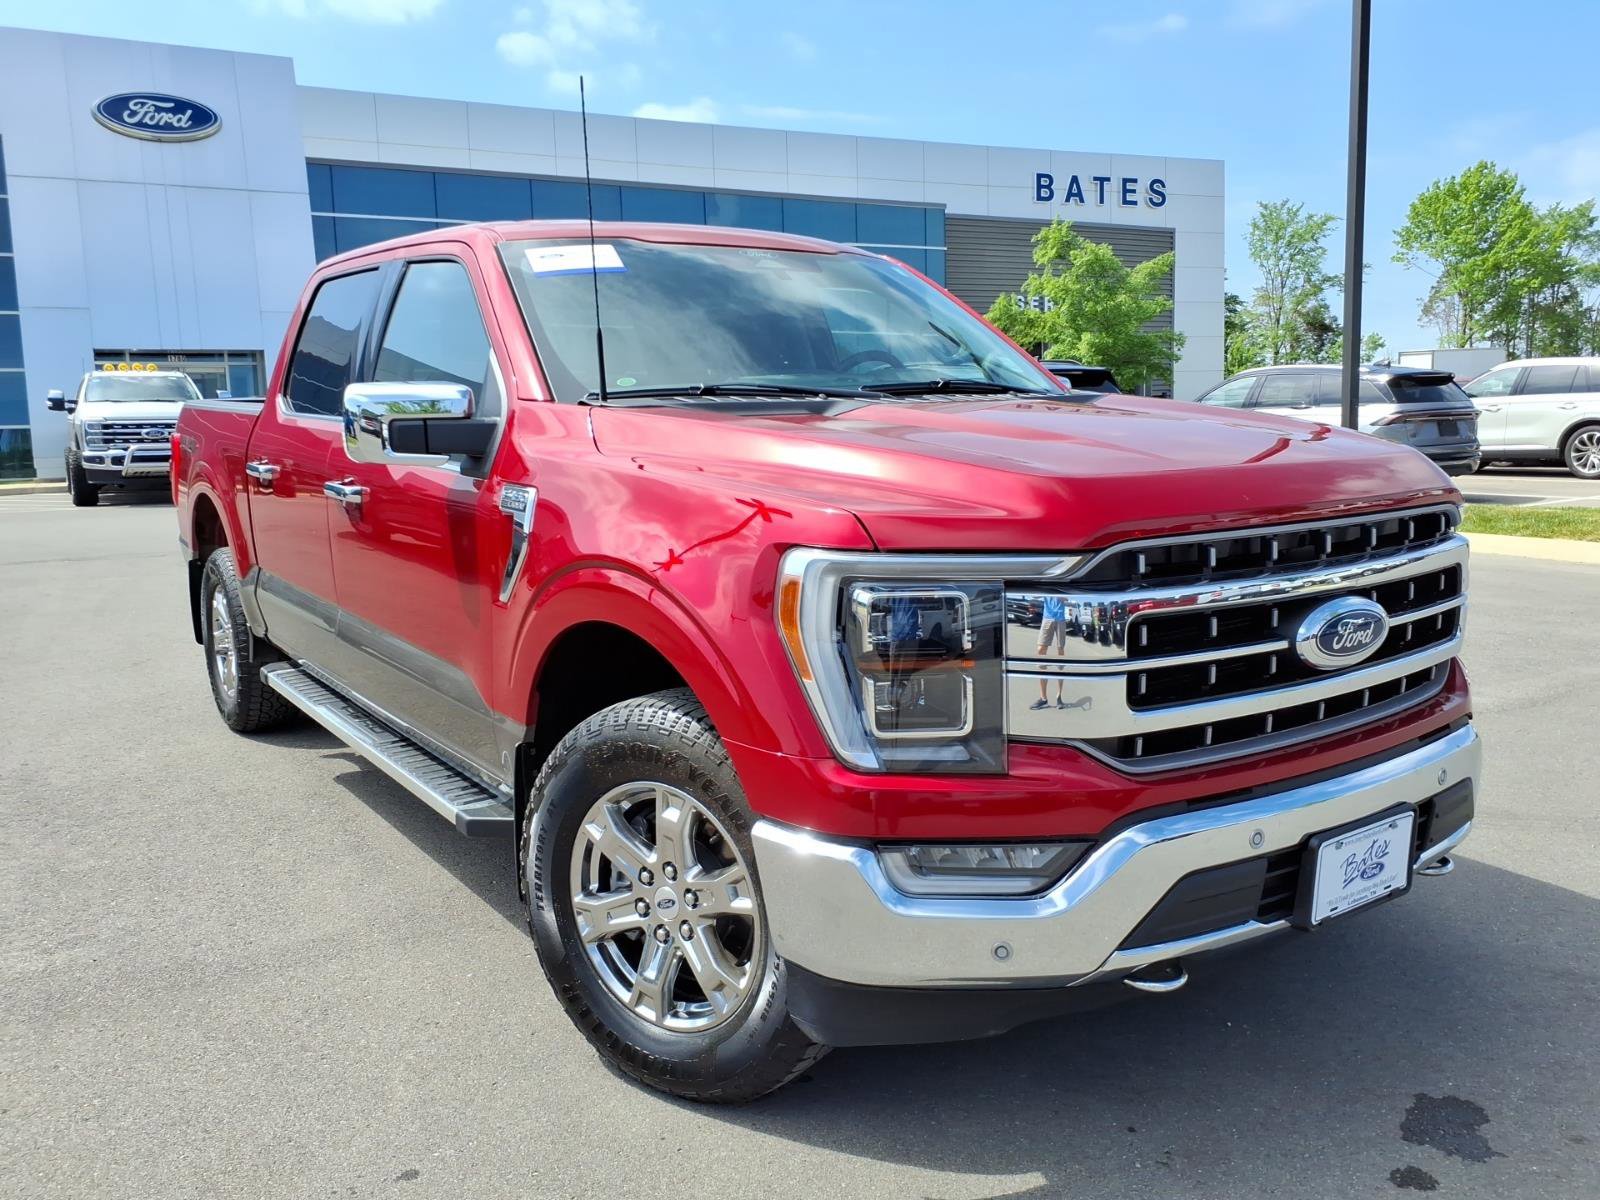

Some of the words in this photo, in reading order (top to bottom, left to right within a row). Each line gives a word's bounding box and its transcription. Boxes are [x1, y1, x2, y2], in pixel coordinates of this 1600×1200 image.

[123, 99, 193, 128] Ford
[1034, 172, 1168, 208] BATES
[1332, 617, 1375, 650] Ford
[534, 823, 548, 912] TERRITORY
[546, 798, 558, 817] AT
